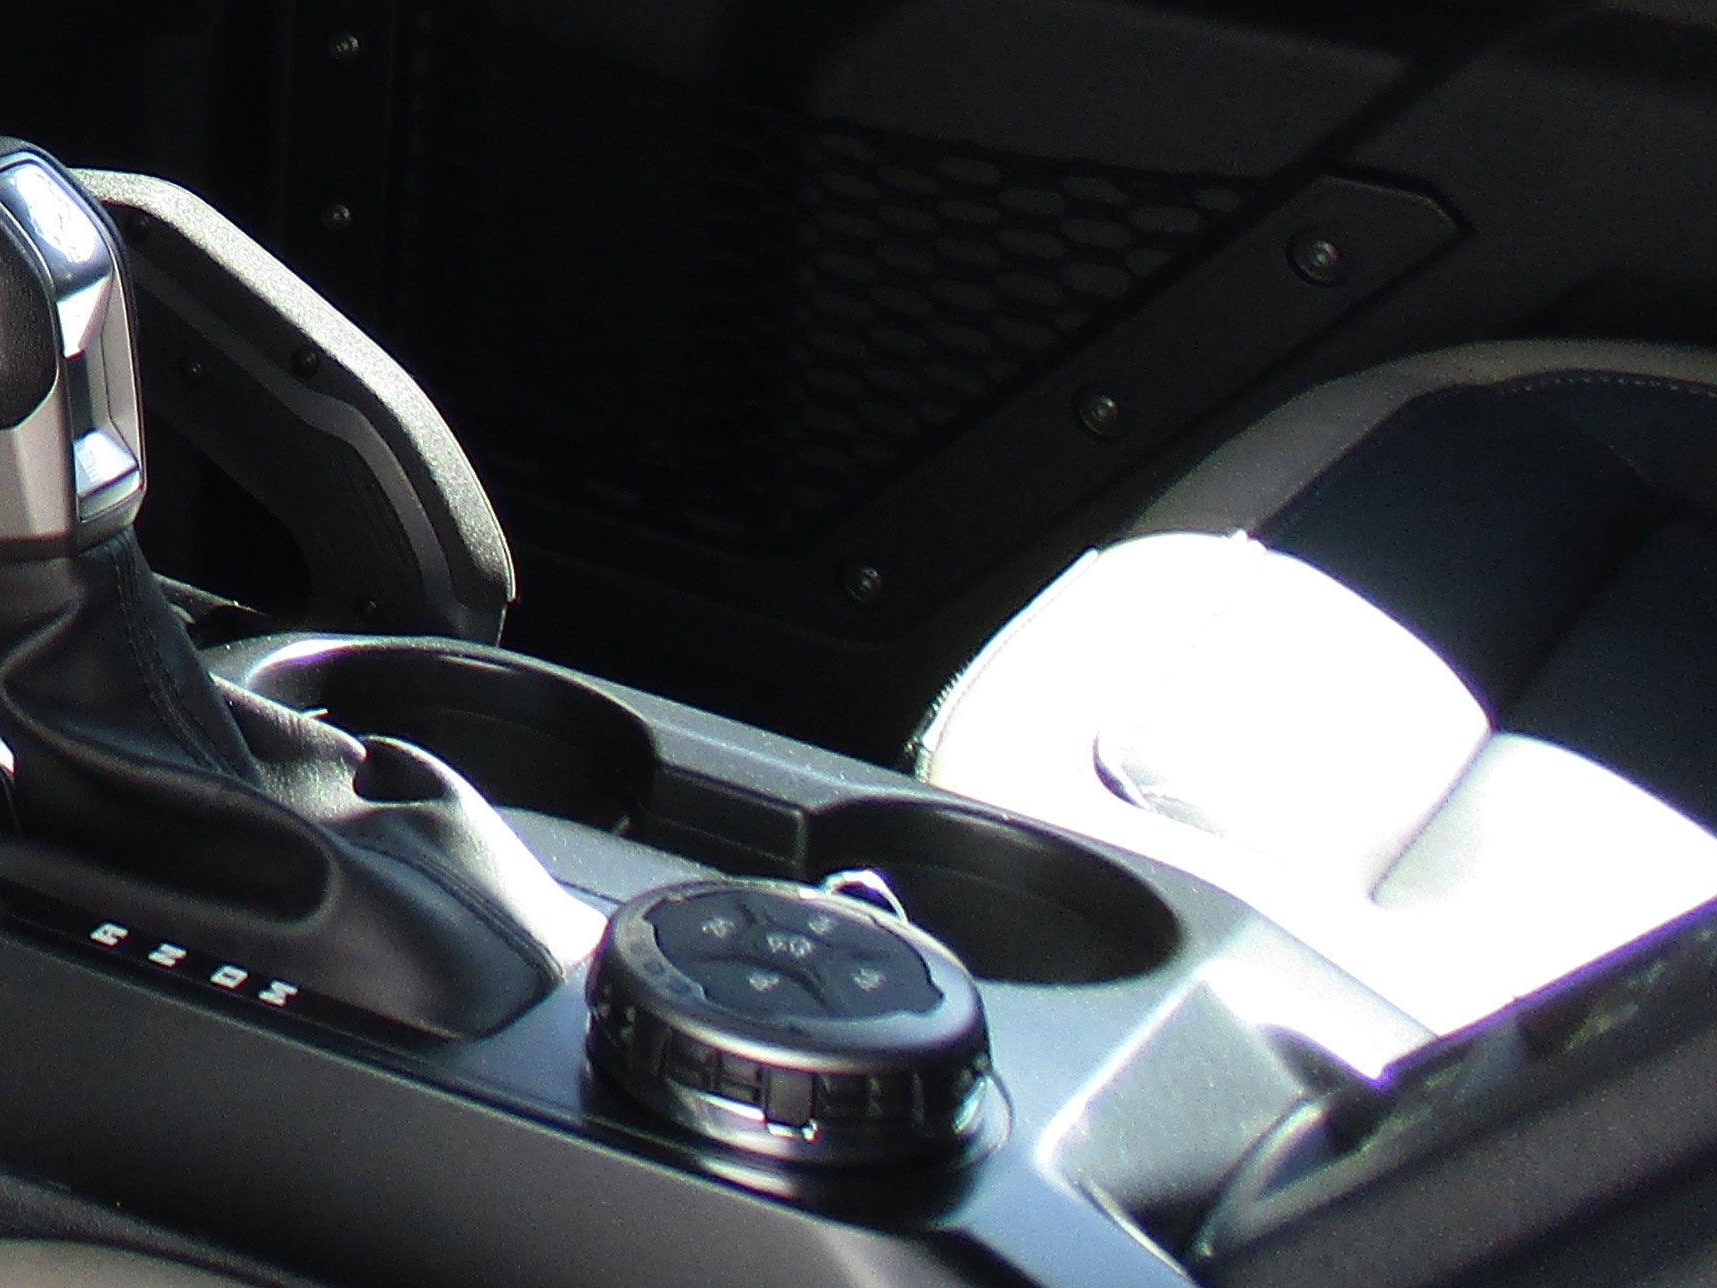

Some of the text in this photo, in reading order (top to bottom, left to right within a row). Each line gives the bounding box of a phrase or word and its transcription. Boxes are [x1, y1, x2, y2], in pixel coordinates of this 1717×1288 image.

[89, 922, 130, 948] R
[147, 942, 188, 967] N
[209, 964, 250, 990] D
[258, 979, 299, 1007] M
